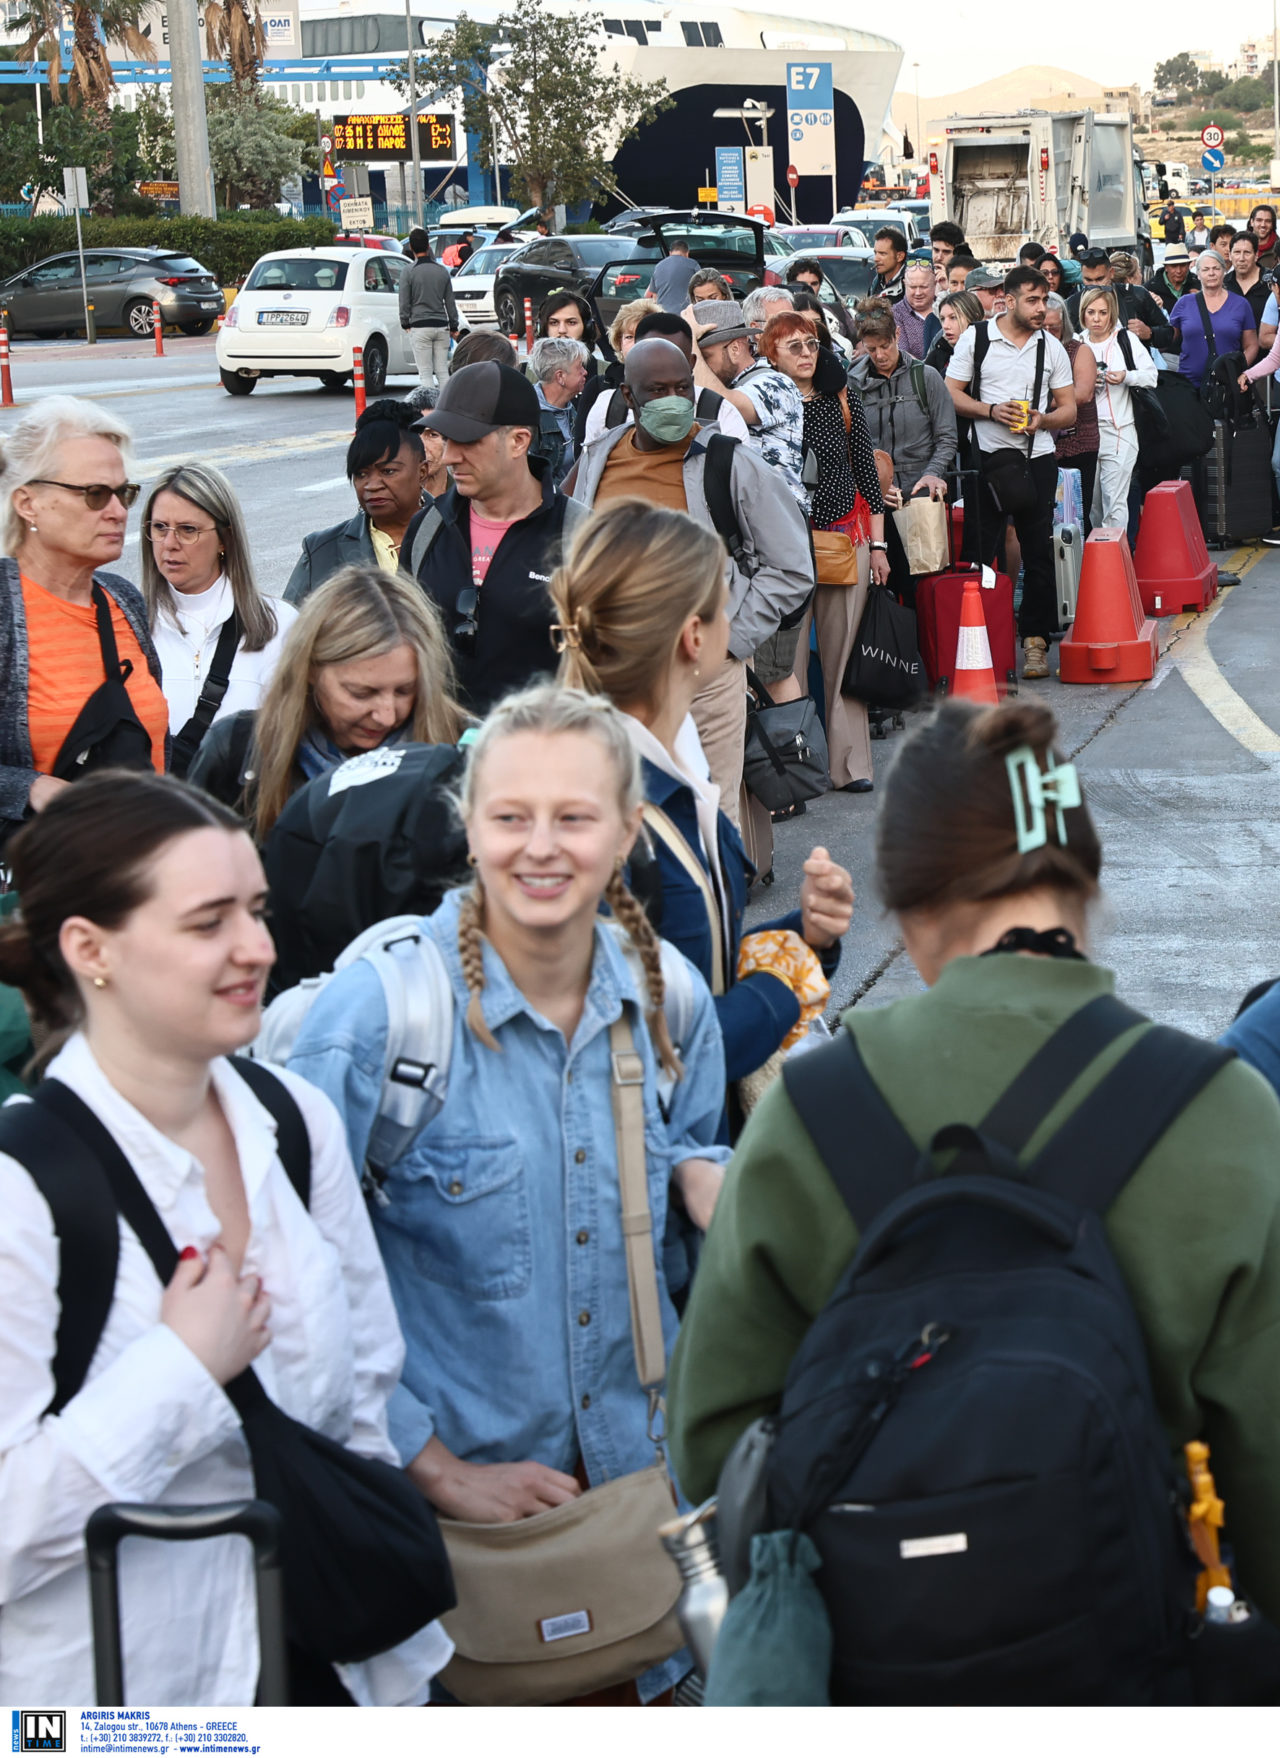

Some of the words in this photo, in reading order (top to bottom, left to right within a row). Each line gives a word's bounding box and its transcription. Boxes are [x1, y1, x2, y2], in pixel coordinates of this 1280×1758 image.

[269, 19, 291, 28] ΟΛΠ
[790, 66, 820, 90] E7
[377, 124, 406, 137] ΔΗΛΟΣ
[1206, 131, 1220, 142] 30
[378, 137, 406, 149] ΠΑΡΟΣ
